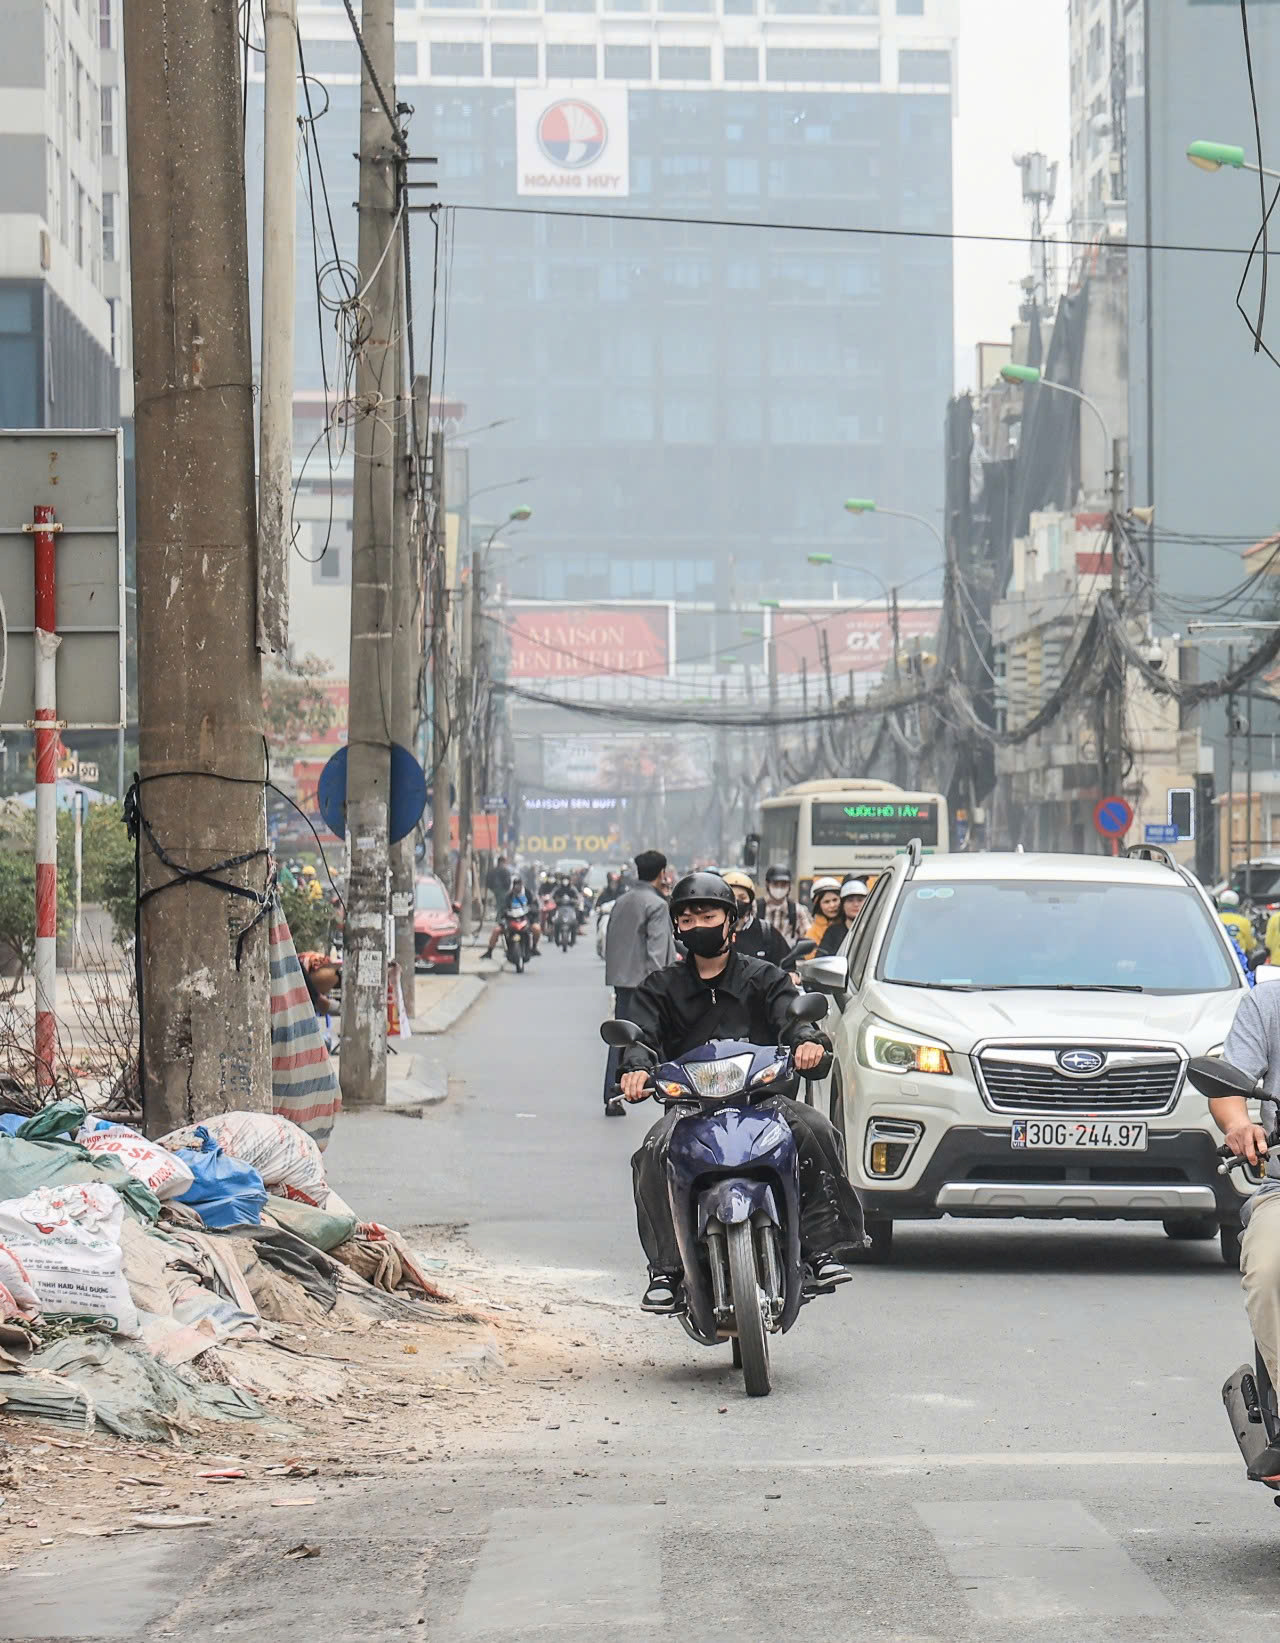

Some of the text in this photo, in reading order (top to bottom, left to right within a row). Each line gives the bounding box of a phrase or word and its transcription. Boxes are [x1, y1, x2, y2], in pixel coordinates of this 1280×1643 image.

[587, 174, 621, 188] HUY
[527, 625, 625, 646] MAISON
[847, 631, 882, 649] GX
[556, 650, 651, 670] BUFFET
[525, 799, 568, 808] MAISON
[570, 799, 590, 808] SEN
[713, 1107, 741, 1116] HONDA
[1029, 1123, 1143, 1147] 30G-244.97
